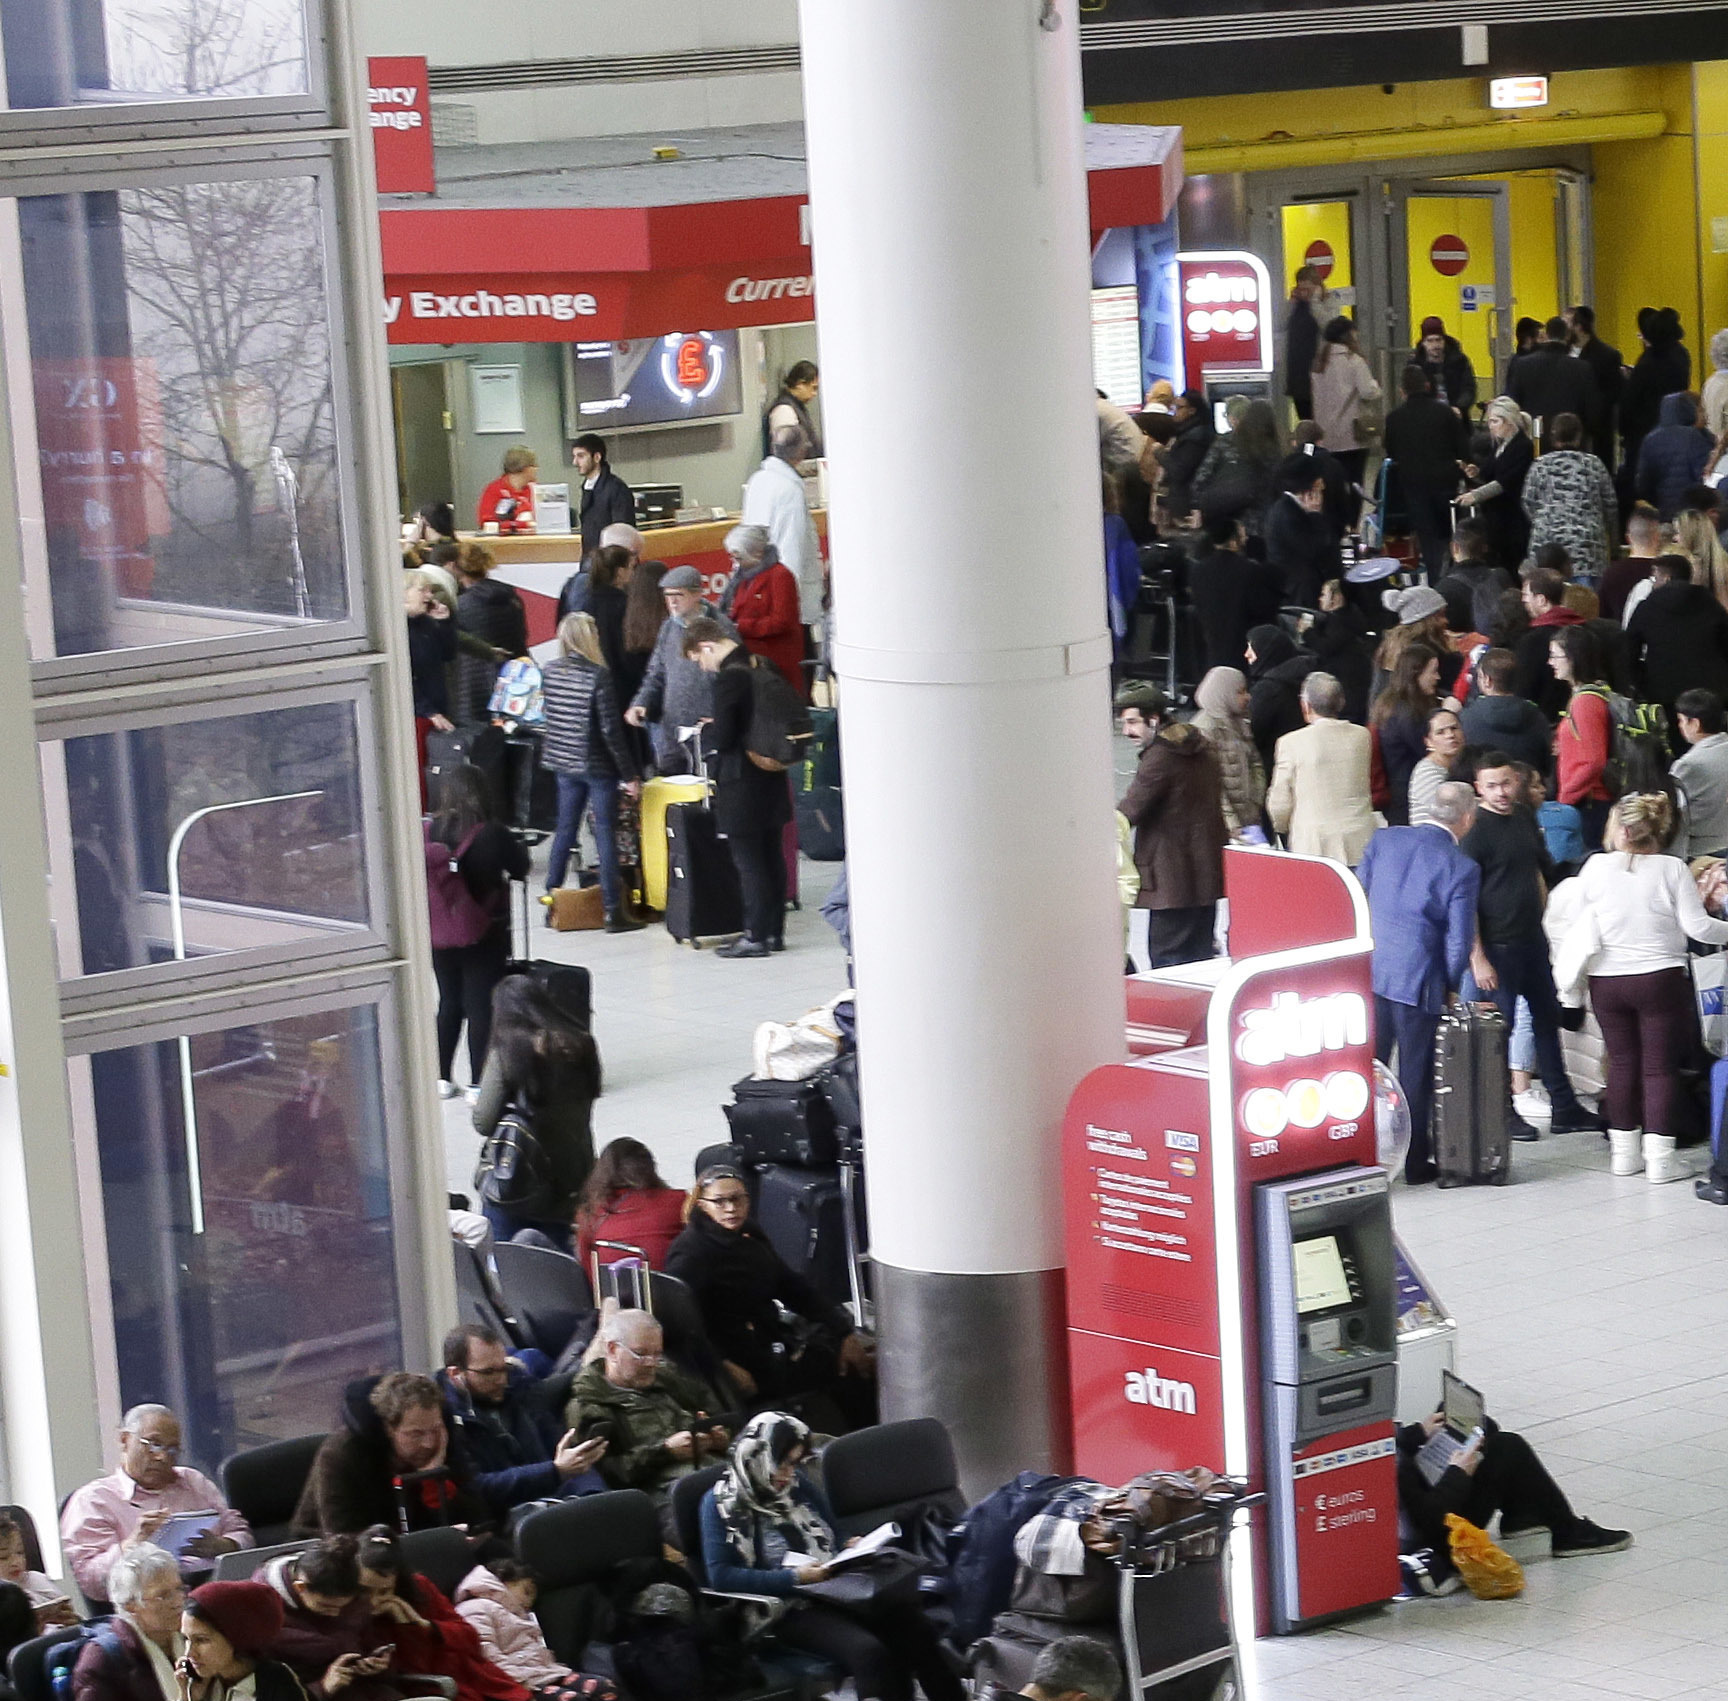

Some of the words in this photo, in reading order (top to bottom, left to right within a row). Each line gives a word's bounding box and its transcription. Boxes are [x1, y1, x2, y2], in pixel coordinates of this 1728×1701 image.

[409, 289, 598, 321] Exchange
[1236, 991, 1369, 1066] atm
[1249, 1139, 1280, 1157] EUR
[1123, 1367, 1197, 1415] atm
[1328, 1489, 1365, 1508] euros
[1328, 1508, 1377, 1529] sterling
